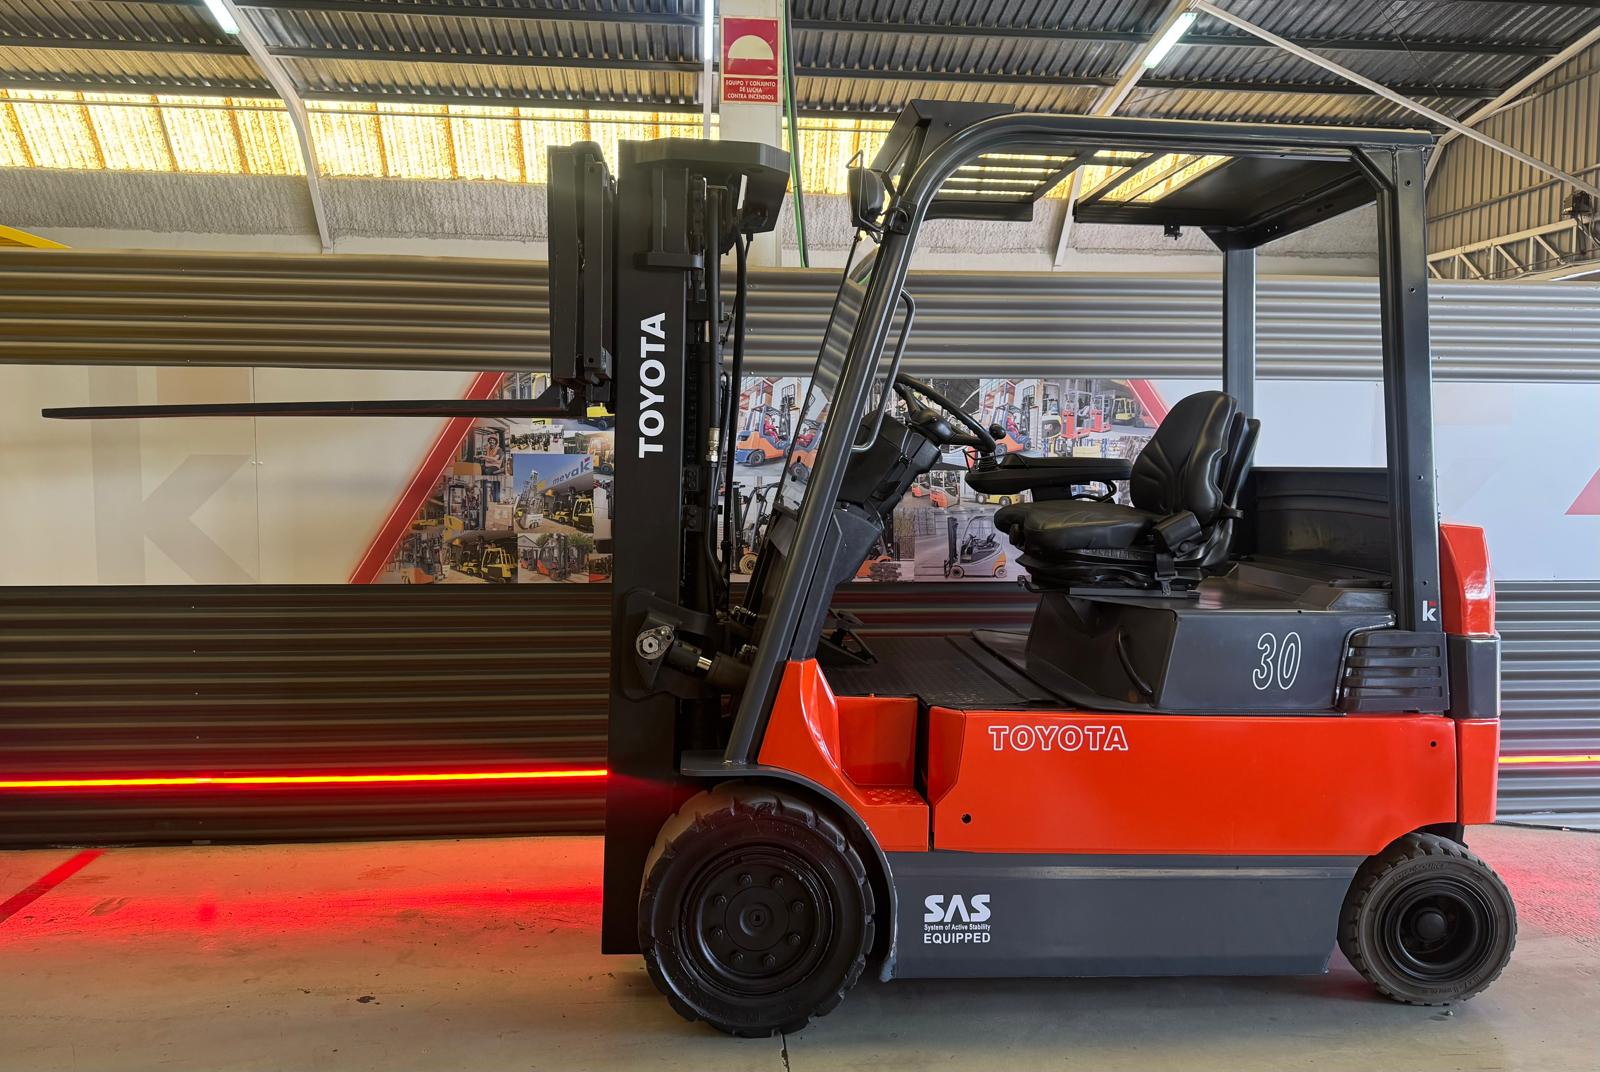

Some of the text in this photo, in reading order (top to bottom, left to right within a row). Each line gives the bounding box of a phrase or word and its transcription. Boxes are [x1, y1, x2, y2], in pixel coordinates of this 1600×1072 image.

[638, 312, 666, 458] TOYOTA
[552, 457, 591, 485] mevak
[1252, 631, 1302, 691] 30
[988, 725, 1128, 751] TOYOTA
[924, 894, 991, 922] SAS
[924, 933, 990, 944] EQUIPPED
